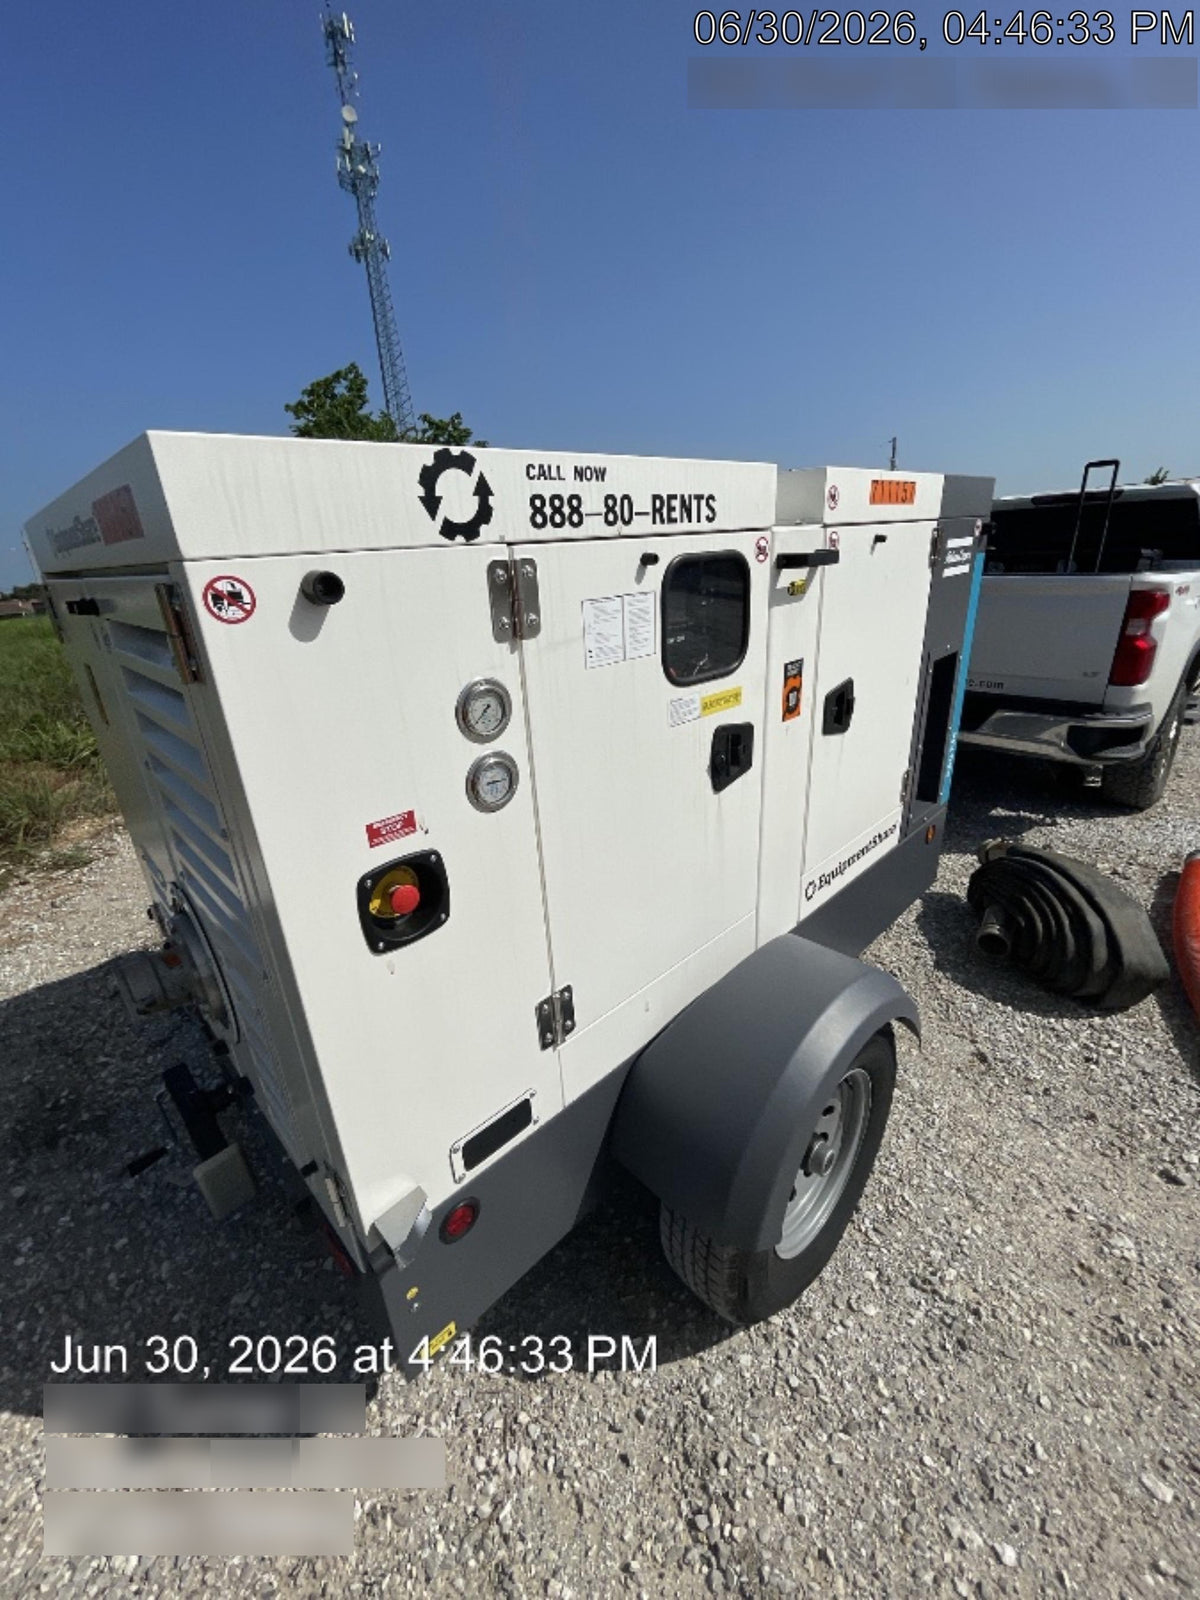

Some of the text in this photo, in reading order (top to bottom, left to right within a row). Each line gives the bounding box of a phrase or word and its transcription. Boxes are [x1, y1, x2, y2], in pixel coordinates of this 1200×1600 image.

[526, 463, 607, 482] CALL NOW
[529, 493, 717, 529] 888-80-RENTS
